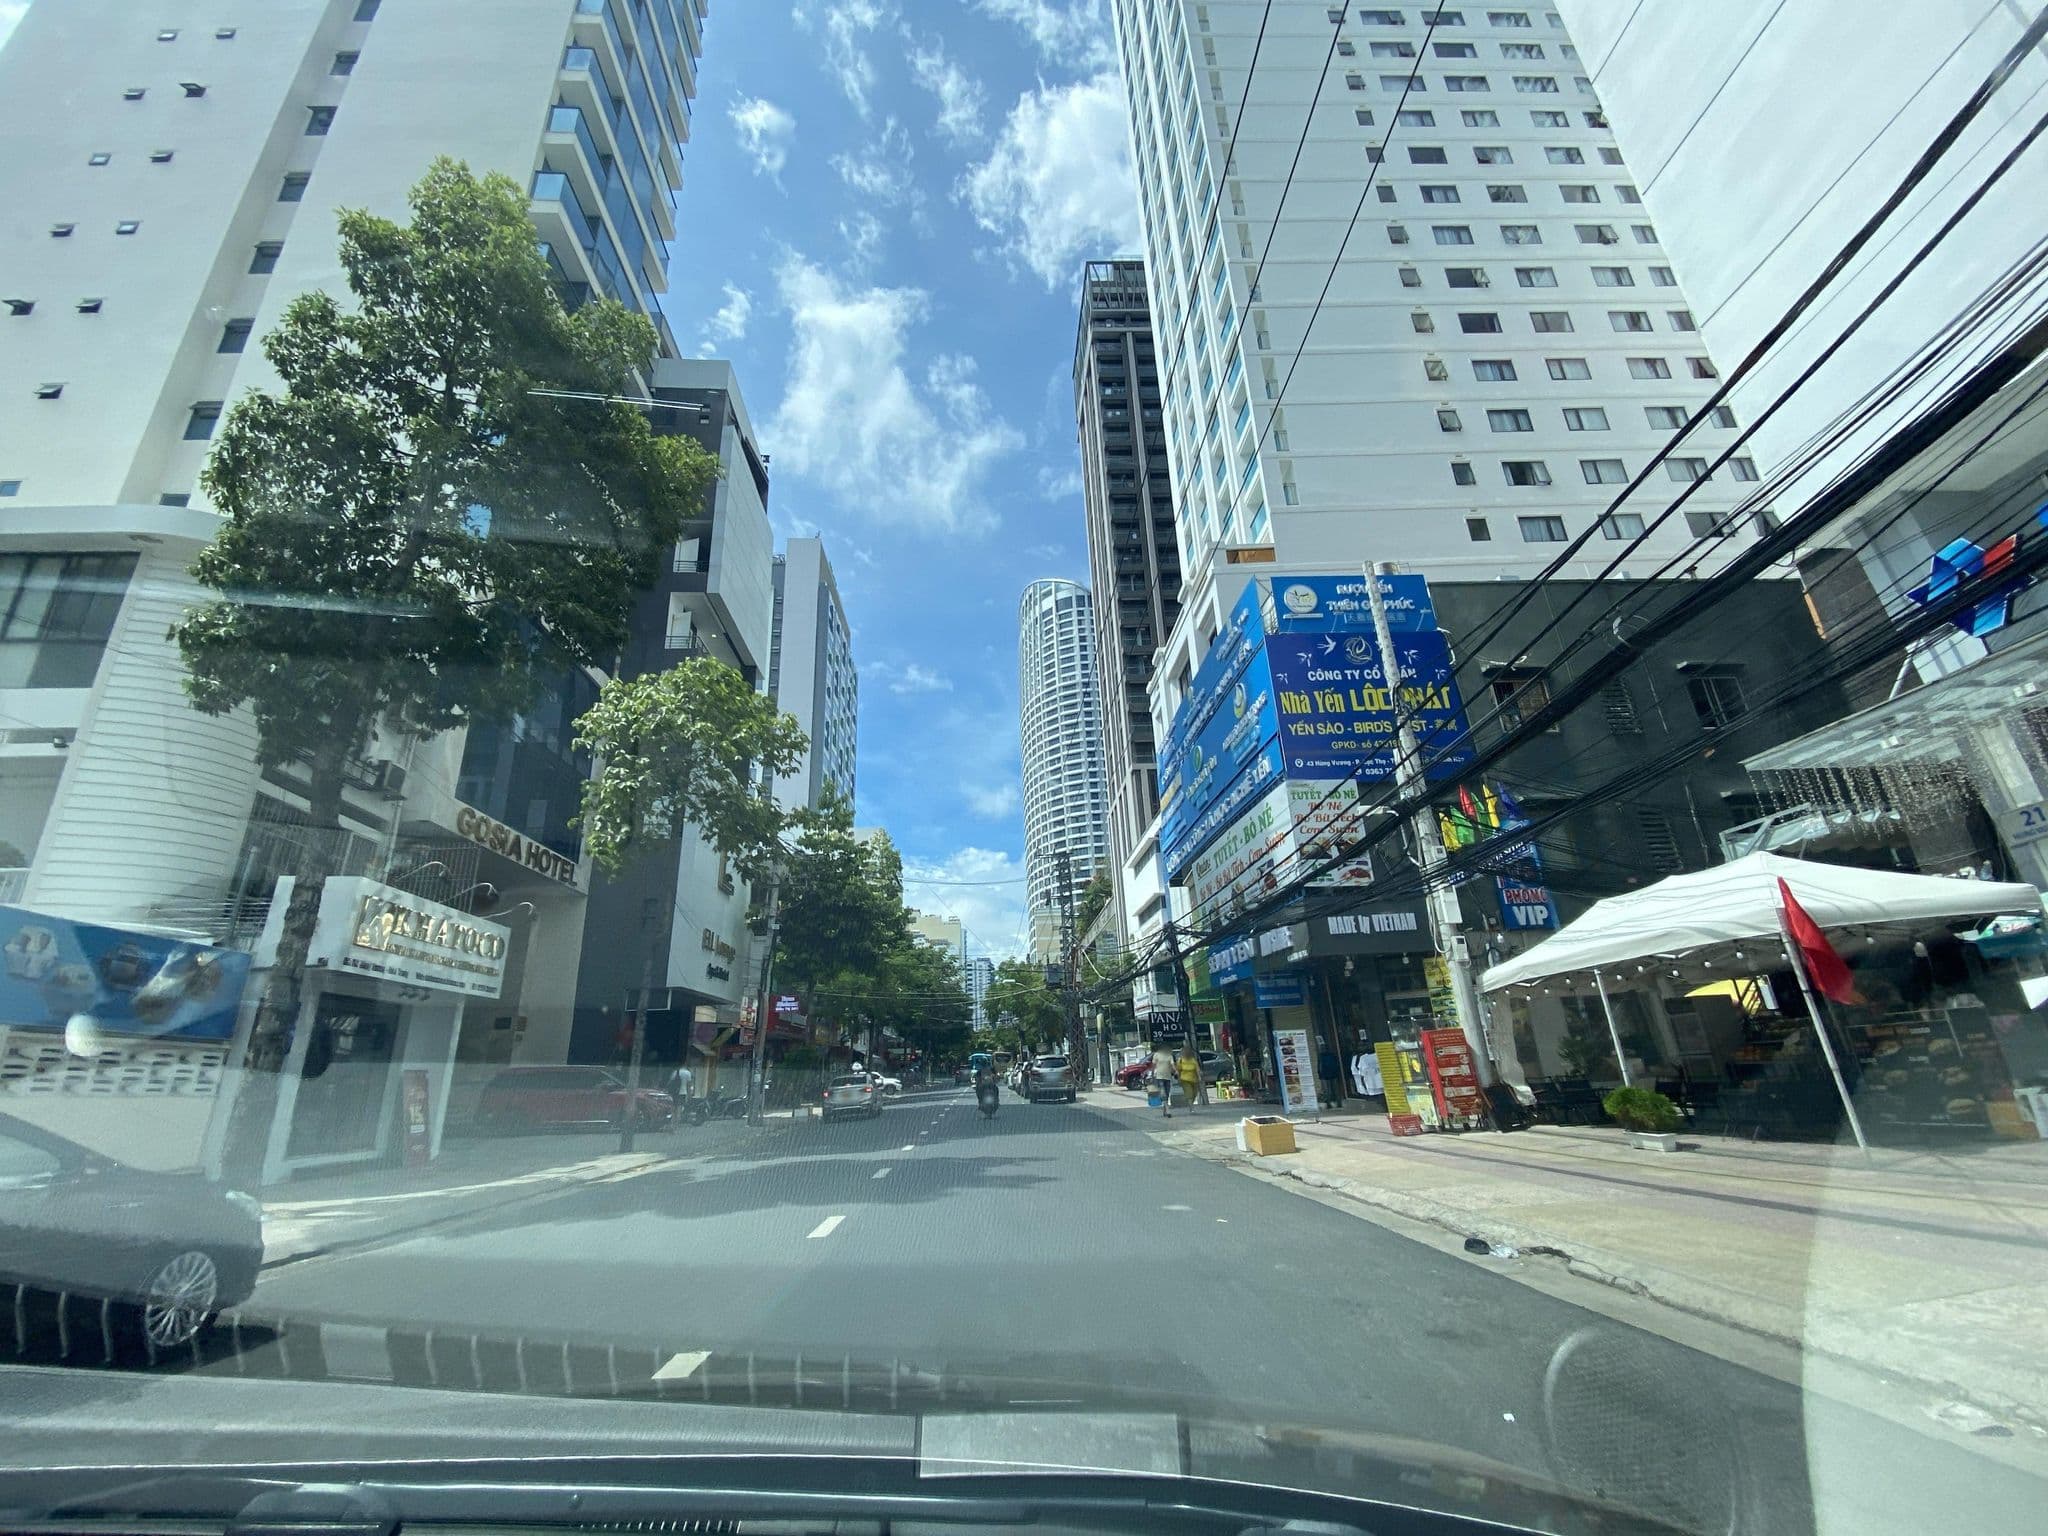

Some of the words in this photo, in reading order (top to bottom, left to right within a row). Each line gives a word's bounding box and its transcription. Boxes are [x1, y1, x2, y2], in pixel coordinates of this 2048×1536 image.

[1382, 596, 1416, 610] PHÚC
[1307, 666, 1342, 682] CÔNG
[1344, 668, 1360, 680] TY
[1364, 664, 1380, 680] CỔ
[1280, 687, 1312, 715] Nhà
[1313, 686, 1346, 714] Yến
[1349, 682, 1393, 715] LỘC
[1288, 719, 1315, 736] YẾN
[1316, 719, 1345, 734] SÀO
[1292, 786, 1322, 800] TUYẾT
[2019, 806, 2047, 827] 21
[1213, 830, 1239, 868] TUYẾT
[1256, 802, 1275, 833] NÉ
[524, 841, 578, 887] HOTEL
[1327, 915, 1357, 934] MADE
[1371, 912, 1417, 932] VIETNAM
[1511, 905, 1548, 925] VIP
